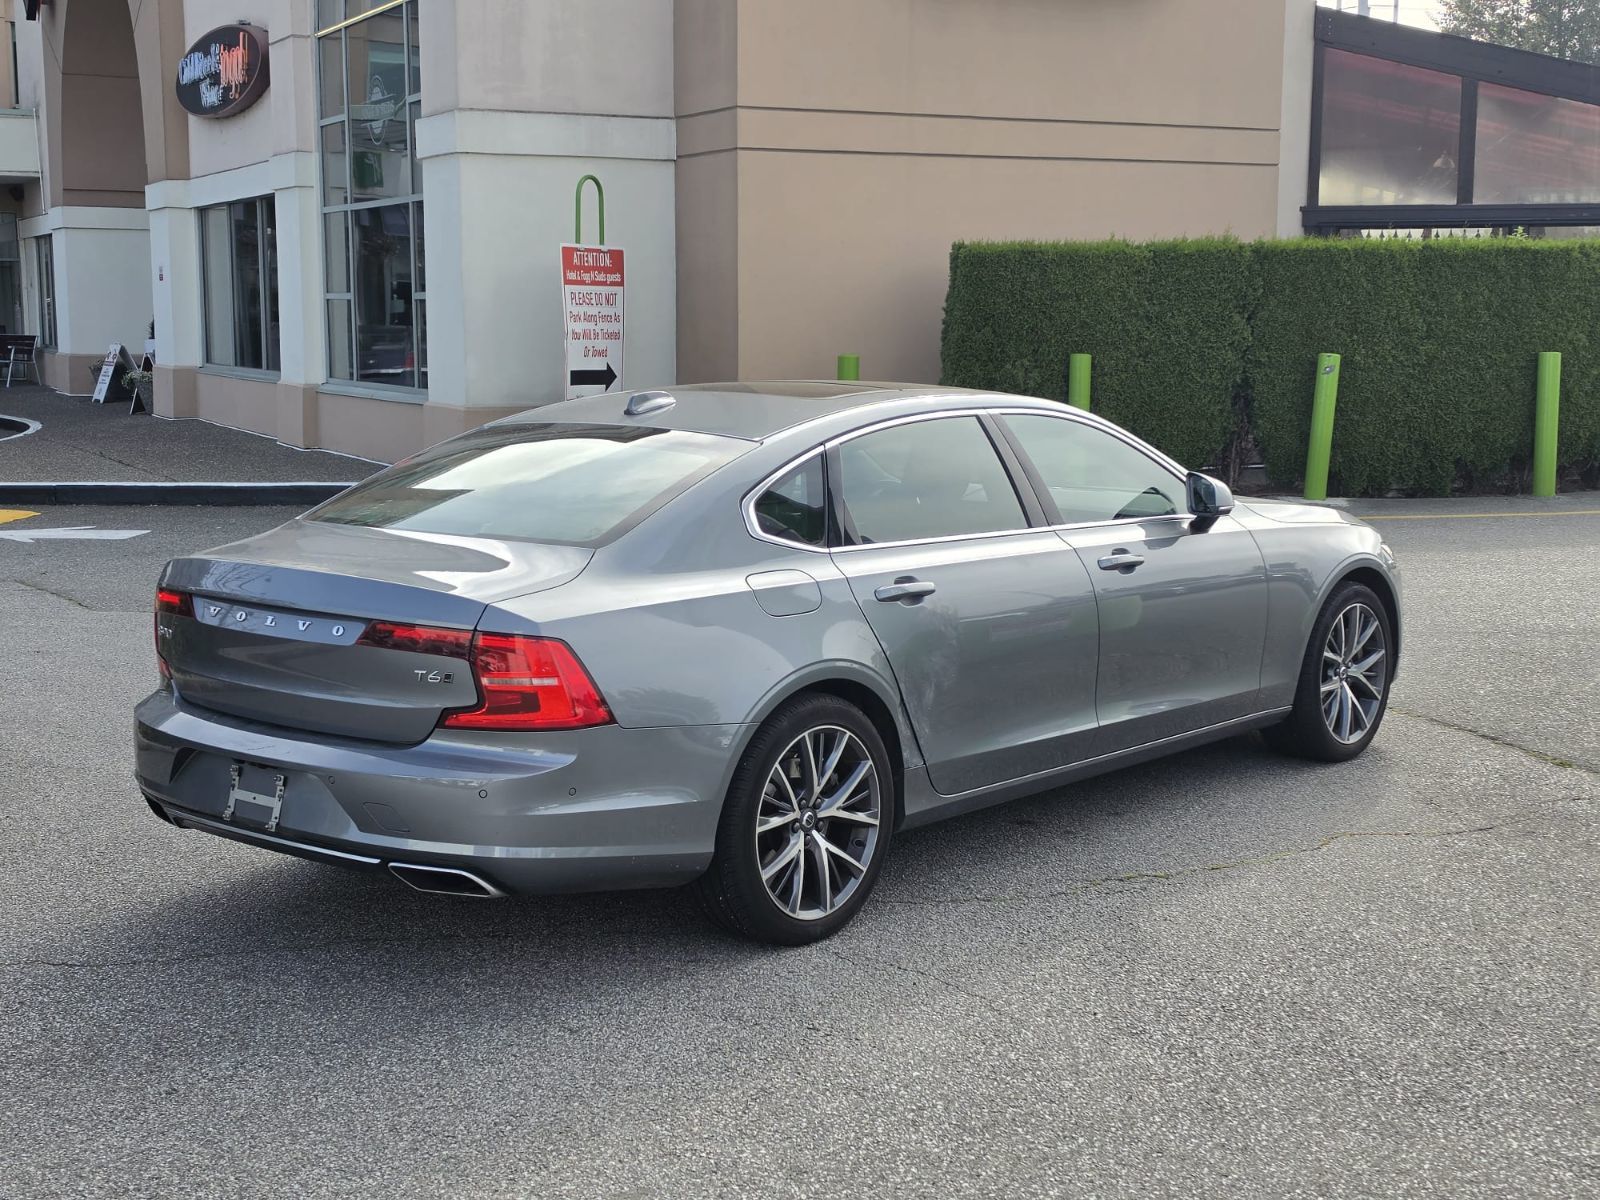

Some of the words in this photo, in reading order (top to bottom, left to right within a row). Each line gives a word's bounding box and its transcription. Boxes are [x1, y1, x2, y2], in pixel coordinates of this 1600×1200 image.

[573, 251, 613, 268] ATTENTION:
[606, 271, 621, 285] guests
[570, 291, 594, 306] PLEASE
[594, 292, 603, 306] DO
[604, 292, 618, 307] NOT
[569, 310, 582, 324] Park
[582, 310, 598, 326] Along
[598, 311, 613, 324] Fence
[613, 311, 621, 324] As
[582, 328, 592, 341] Will
[592, 328, 600, 341] Be
[600, 328, 620, 341] Ticketed
[583, 345, 591, 358] Or
[591, 345, 608, 358] Towed
[208, 604, 345, 637] VOLVO
[414, 669, 441, 683] T6
